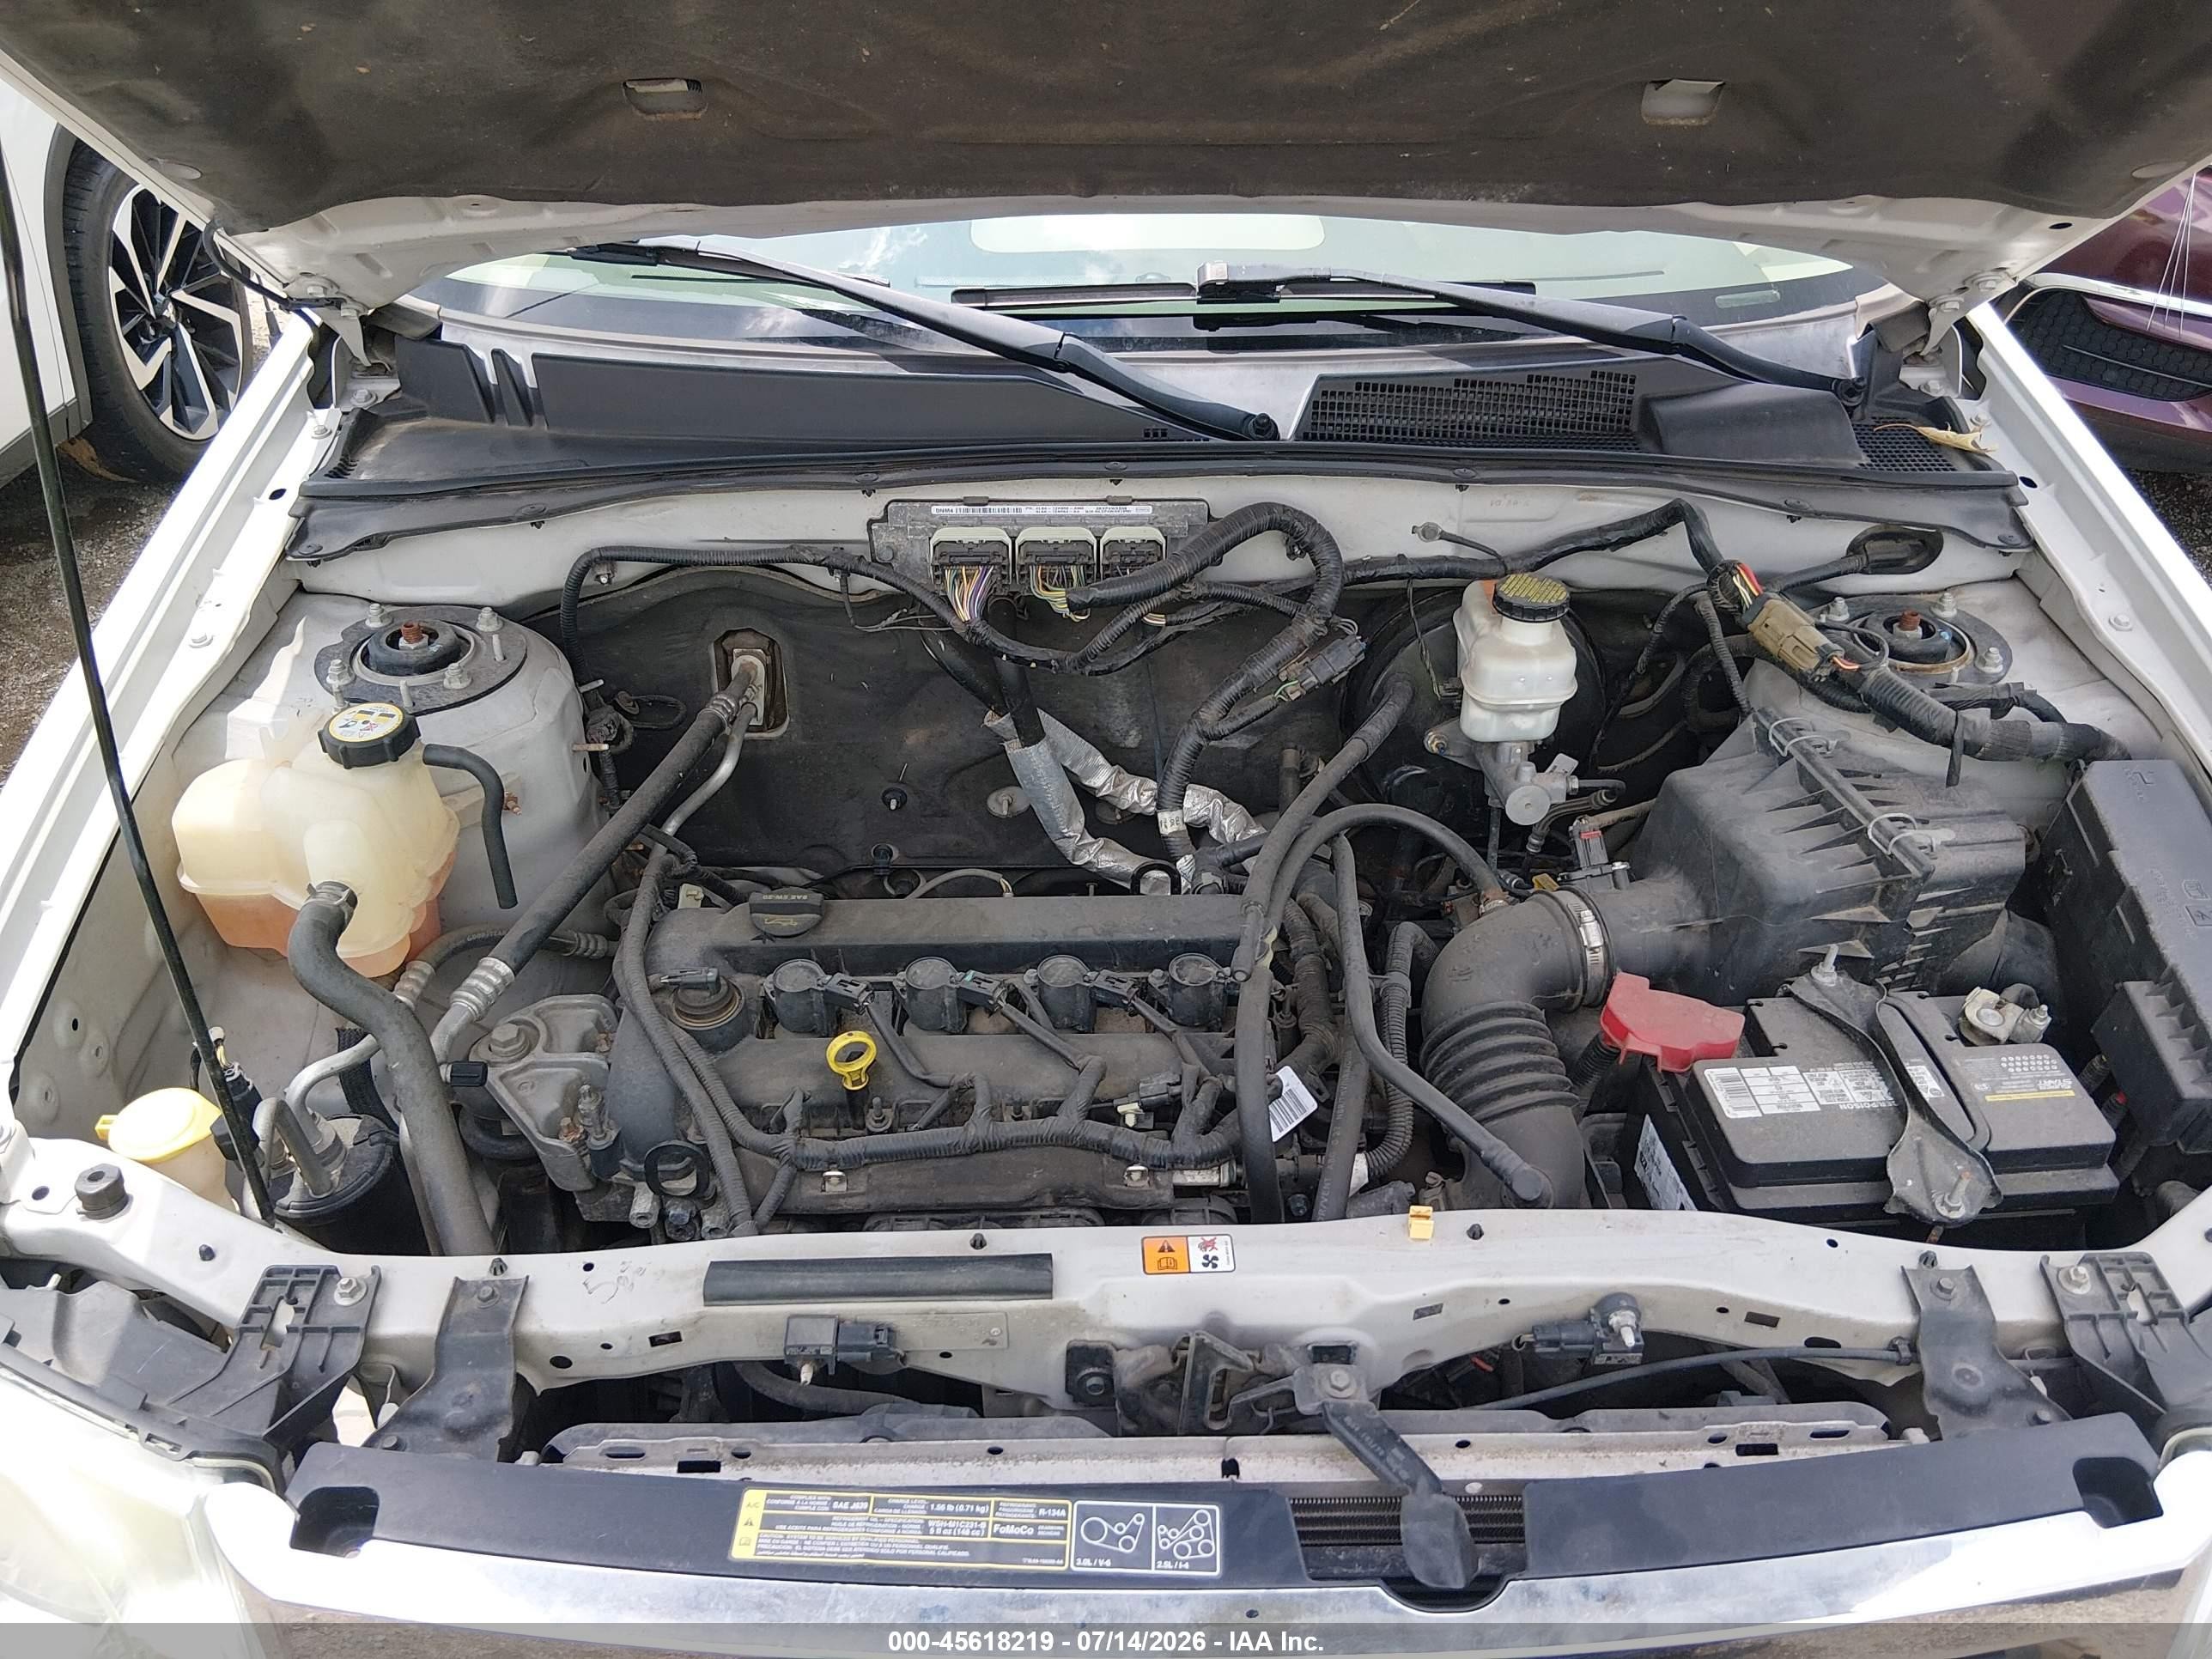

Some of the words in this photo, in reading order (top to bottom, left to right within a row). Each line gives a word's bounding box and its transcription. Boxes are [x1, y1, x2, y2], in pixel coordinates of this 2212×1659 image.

[955, 1504, 974, 1513] (0.71
[975, 1504, 989, 1514] kg)
[1038, 1508, 1066, 1517] R-134A
[993, 1523, 1035, 1535] FoMoCo
